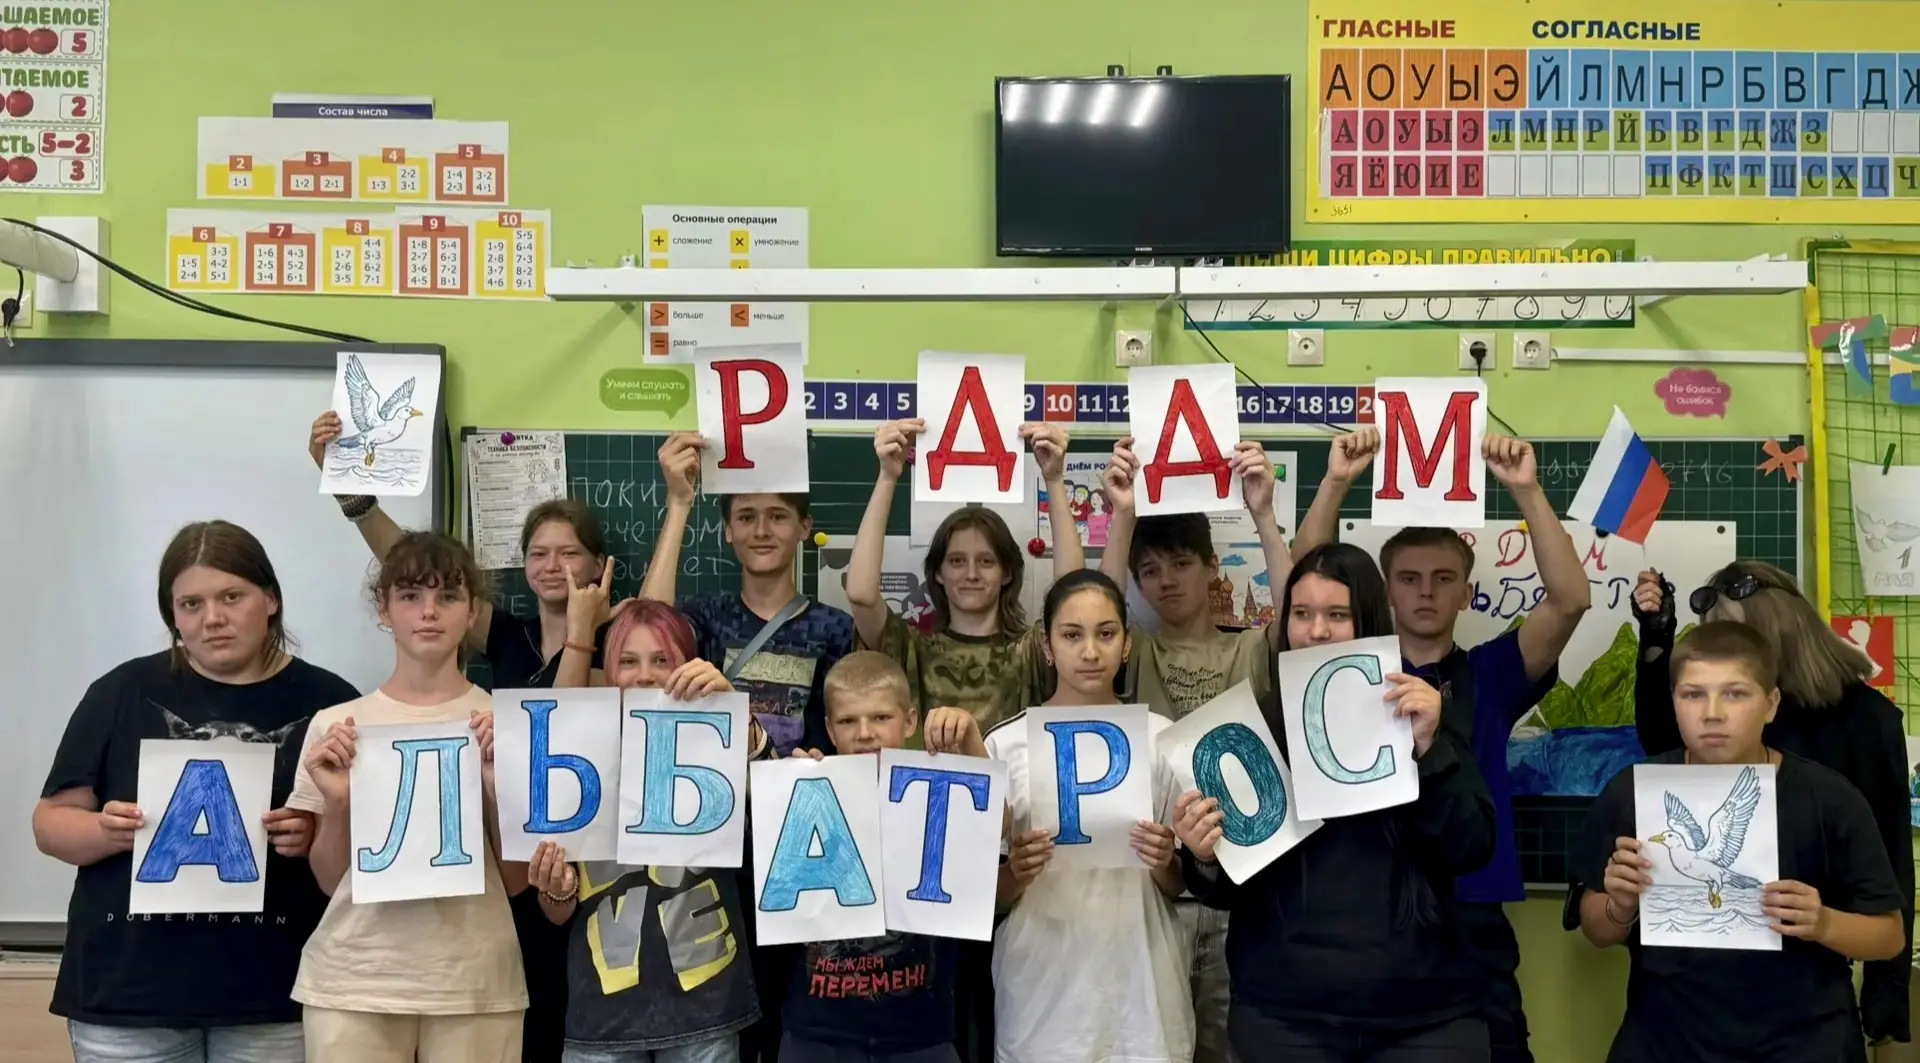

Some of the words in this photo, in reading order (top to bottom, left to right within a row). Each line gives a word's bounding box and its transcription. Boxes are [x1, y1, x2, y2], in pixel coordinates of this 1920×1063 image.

[1322, 19, 1456, 39] ГЛАСНЫЕ
[1532, 20, 1701, 41] СОГЛАСНЫЕ
[71, 32, 87, 53] 5
[0, 68, 89, 88] ТАЕМОЕ
[1326, 64, 1352, 101] А
[1367, 64, 1395, 101] О
[1411, 64, 1435, 101] У
[1450, 65, 1479, 101] Ы
[1493, 64, 1519, 102] Э
[1536, 56, 1560, 101] Й
[1578, 65, 1602, 101] Л
[1617, 65, 1645, 102] М
[1660, 66, 1683, 102] Н
[1702, 67, 1724, 102] Р
[1743, 67, 1765, 103] Б
[1785, 67, 1807, 103] В
[1826, 68, 1845, 104] Г
[1862, 68, 1888, 110] Д
[71, 96, 87, 117] 2
[318, 106, 354, 117] Состав
[357, 106, 388, 118] числа
[1335, 119, 1355, 143] А
[1366, 118, 1384, 144] О
[1398, 119, 1417, 144] У
[1425, 119, 1453, 143] Ы
[1462, 118, 1479, 144] Э
[1492, 119, 1512, 144] Л
[1524, 119, 1548, 143] М
[1555, 119, 1575, 143] Н
[1586, 119, 1604, 143] Р
[1618, 113, 1638, 143] Й
[1648, 119, 1666, 143] Б
[1682, 119, 1700, 144] В
[1714, 119, 1731, 143] Г
[1742, 119, 1762, 149] Д
[1770, 119, 1796, 144] Ж
[1805, 119, 1822, 144] З
[313, 154, 322, 165] 3
[389, 150, 398, 161] 4
[465, 146, 474, 158] 5
[69, 160, 85, 181] 3
[236, 158, 245, 169] 2
[1334, 163, 1354, 188] Я
[1368, 158, 1385, 189] Ё
[1394, 163, 1421, 189] Ю
[1428, 163, 1450, 188] И
[1462, 163, 1480, 188] Е
[1648, 163, 1670, 188] П
[1679, 163, 1703, 188] Ф
[1713, 163, 1732, 189] К
[1744, 163, 1761, 189] Т
[1771, 163, 1797, 188] Ш
[1807, 163, 1824, 189] С
[1835, 164, 1856, 189] Х
[1866, 164, 1887, 196] Ц
[1897, 165, 1918, 190] Ч
[353, 221, 362, 233] 8
[430, 218, 438, 230] 9
[502, 214, 518, 226] 10
[672, 214, 725, 224] Основные
[727, 215, 777, 226] операции
[200, 229, 208, 240] 6
[276, 226, 285, 237] 7
[672, 237, 713, 245] сложение
[754, 238, 799, 247] умножение
[673, 311, 704, 320] больше
[753, 313, 784, 321] меньше
[673, 339, 697, 348] равно
[1669, 383, 1684, 394] Не
[804, 391, 816, 410] 2
[834, 392, 847, 410] 3
[865, 393, 879, 411] 4
[896, 393, 911, 411] 5
[1024, 393, 1036, 412] 9
[1047, 394, 1073, 412] 10
[1079, 395, 1103, 412] 11
[1237, 396, 1260, 413] 16
[1266, 396, 1287, 413] 17
[1297, 396, 1323, 414] 18
[1328, 396, 1354, 414] 19
[711, 359, 788, 468] Р
[926, 366, 1017, 492] Д
[1144, 379, 1232, 504] Д
[1375, 392, 1479, 501] М
[1066, 461, 1092, 471] ДНЁМ
[1094, 462, 1109, 470] РО
[1302, 654, 1395, 784] С
[521, 699, 601, 833] Ь
[625, 710, 735, 835] Б
[1044, 720, 1130, 845] Р
[1193, 723, 1287, 847] О
[358, 736, 472, 872] Л
[136, 758, 260, 883] А
[889, 765, 990, 903] Т
[758, 777, 877, 912] А
[107, 912, 287, 925] DOBERMANN
[816, 957, 840, 972] МЫ
[843, 953, 884, 972] ЖДЁМ
[809, 964, 926, 999] ПЕРЕМЕН!
